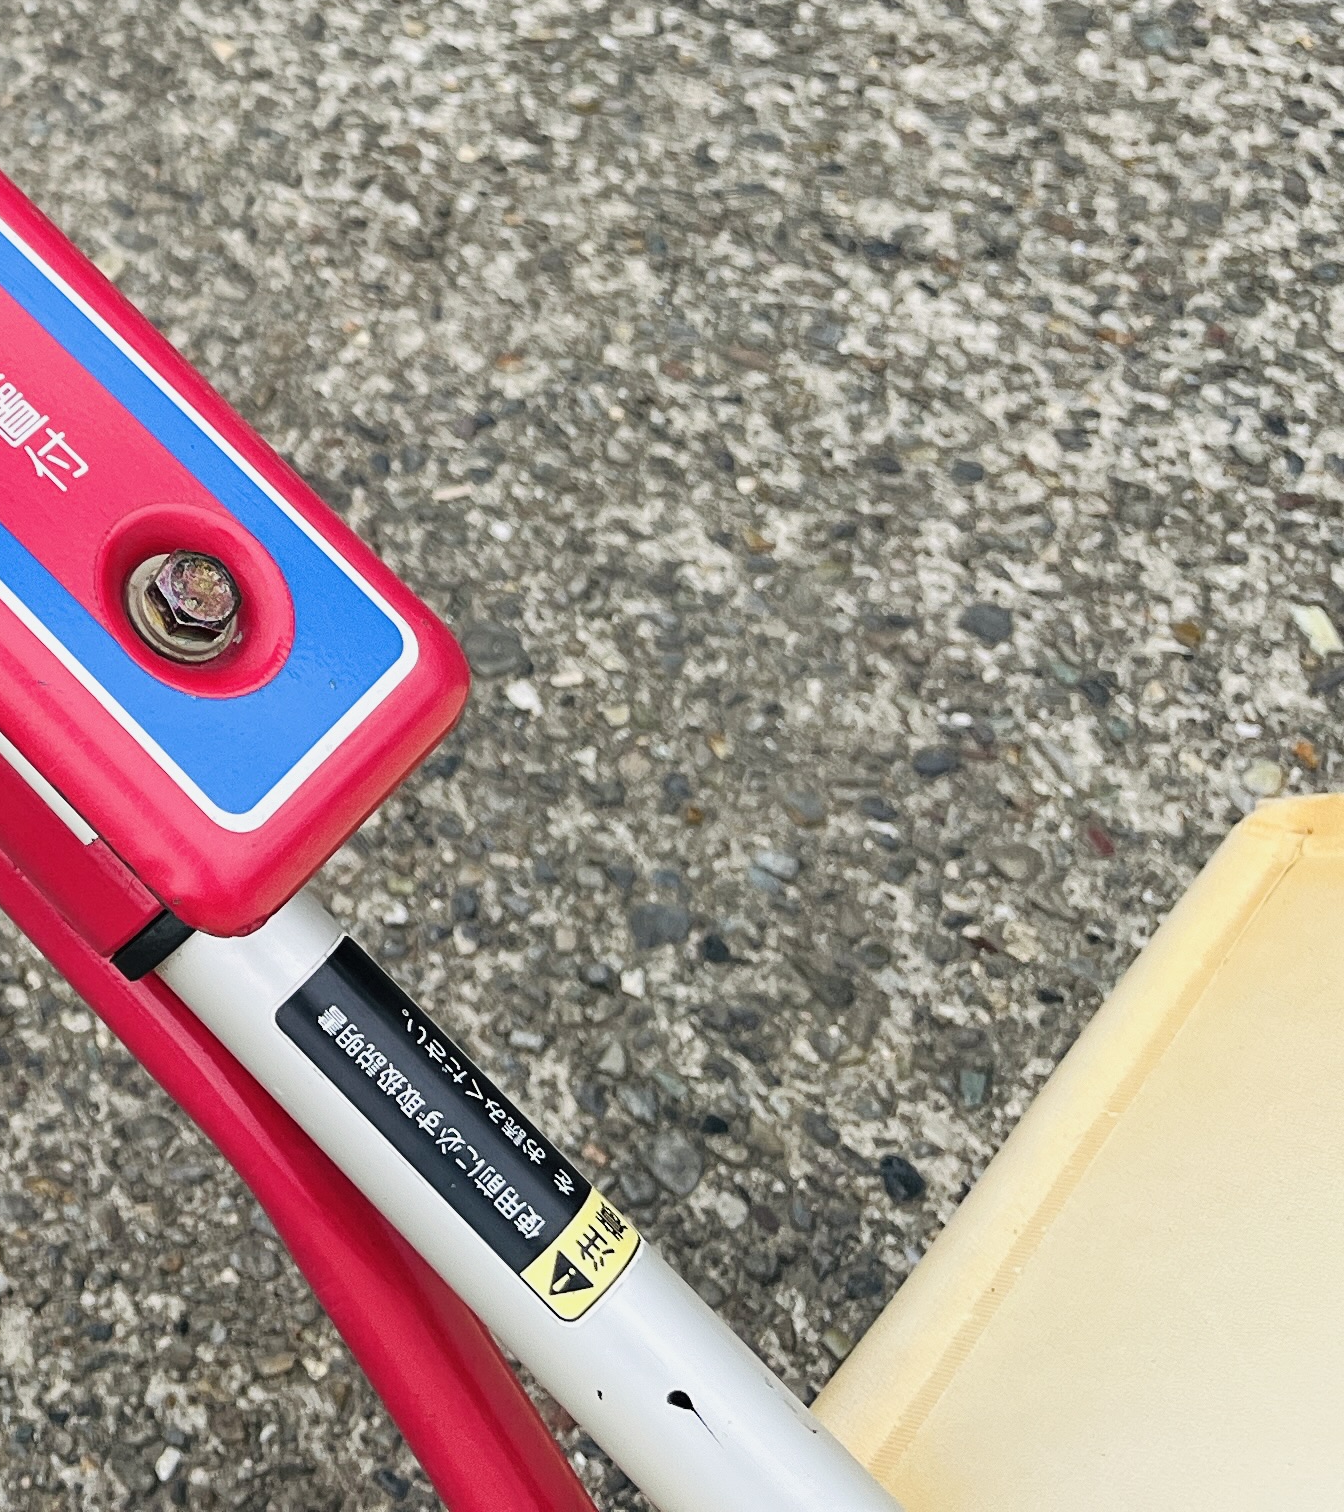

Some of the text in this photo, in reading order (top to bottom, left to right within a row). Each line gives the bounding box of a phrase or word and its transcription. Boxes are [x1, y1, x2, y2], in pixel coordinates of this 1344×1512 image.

[316, 1004, 547, 1241] 使用前に必ず取扱説明書
[575, 1201, 629, 1272] 注意
